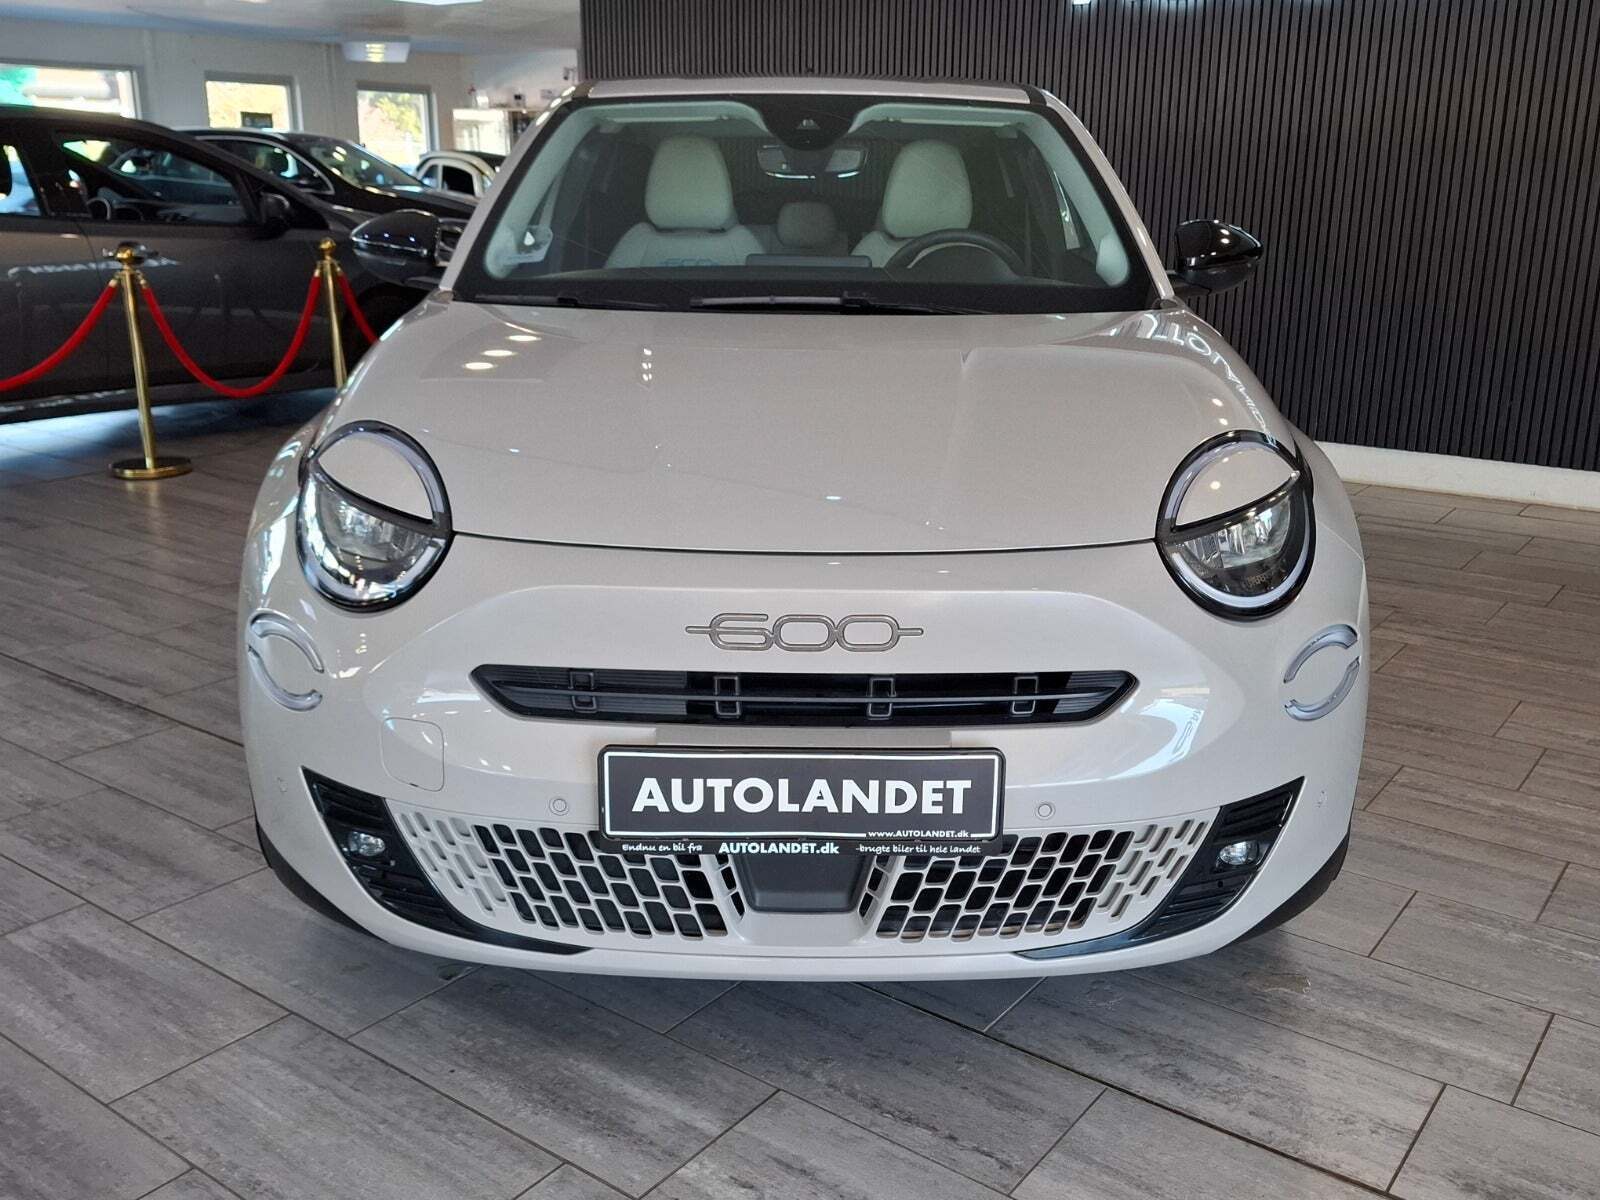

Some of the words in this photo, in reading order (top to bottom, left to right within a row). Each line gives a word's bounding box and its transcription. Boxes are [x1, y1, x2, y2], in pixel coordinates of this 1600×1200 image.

[709, 612, 900, 652] 600
[631, 777, 972, 814] AUTOLANDET
[867, 829, 969, 838] www.AUTOLANDET.dk
[673, 842, 686, 852] bil
[687, 843, 703, 854] fra
[718, 842, 840, 854] AUTOLANDET.dk
[892, 844, 914, 853] biler
[915, 844, 928, 853] til
[929, 844, 948, 853] hele
[949, 845, 981, 854] landet
